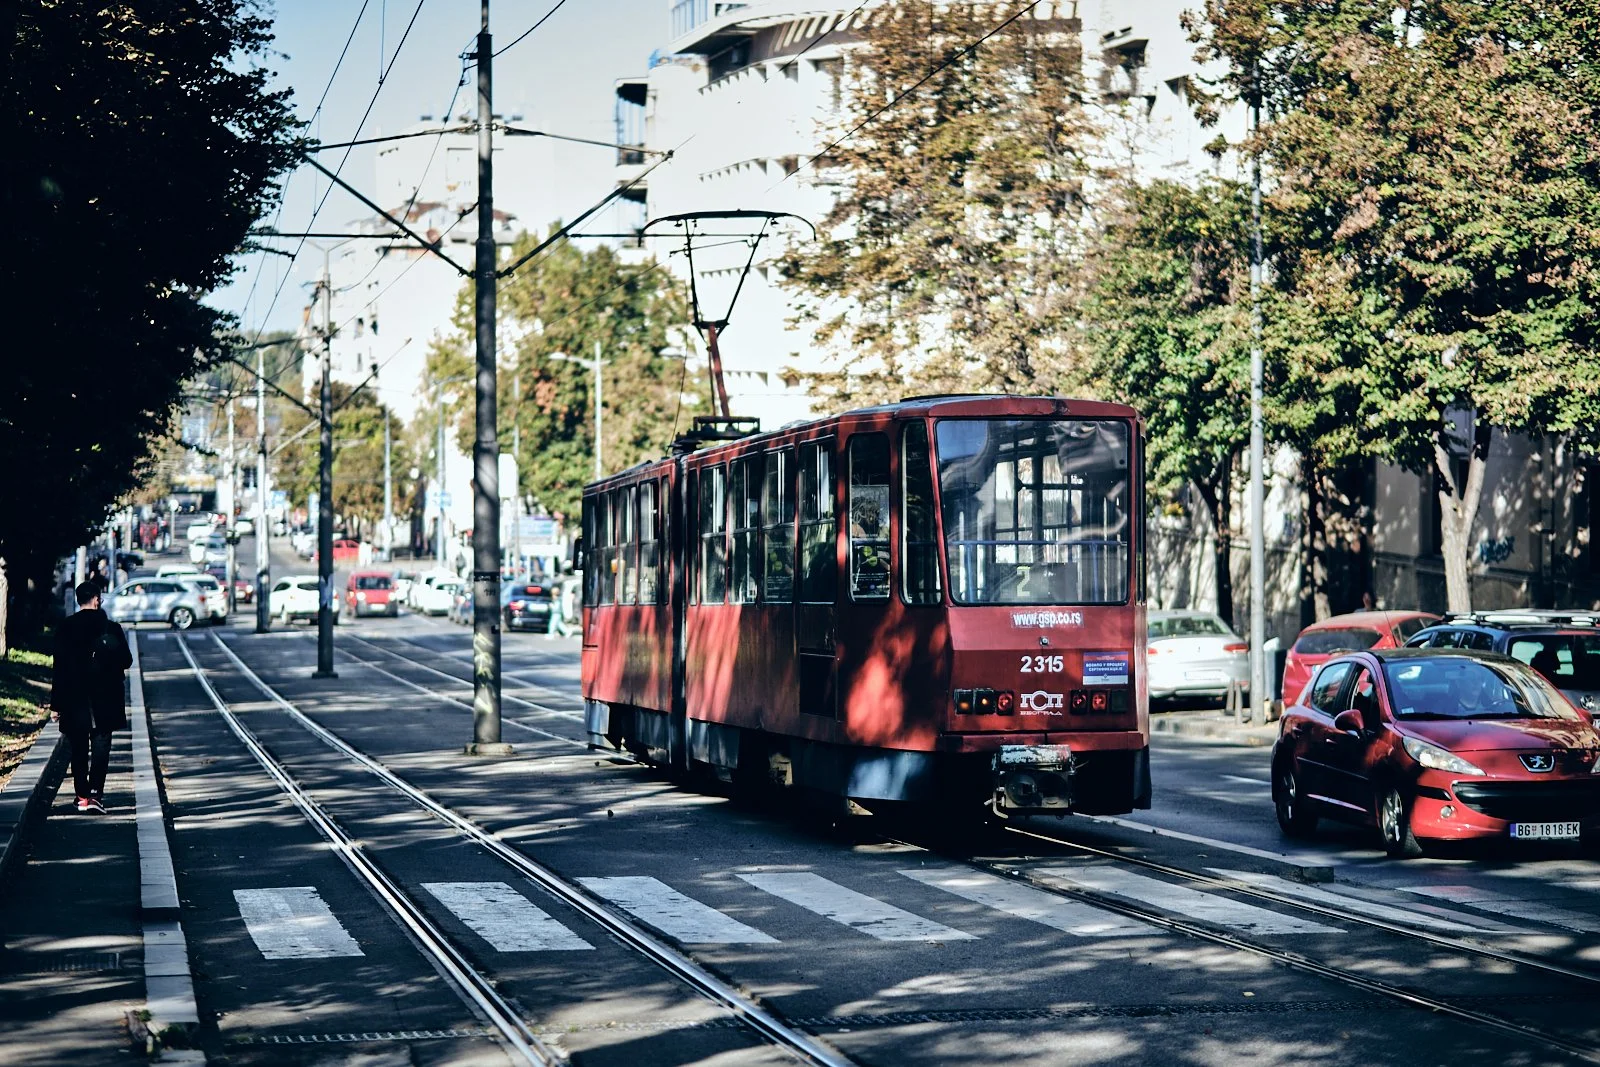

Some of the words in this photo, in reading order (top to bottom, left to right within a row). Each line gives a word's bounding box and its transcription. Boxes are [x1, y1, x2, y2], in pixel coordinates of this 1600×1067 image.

[1016, 565, 1031, 597] 2
[1013, 612, 1081, 628] www.gsp.co.rs
[1020, 655, 1064, 673] 2315
[1518, 825, 1530, 836] BG
